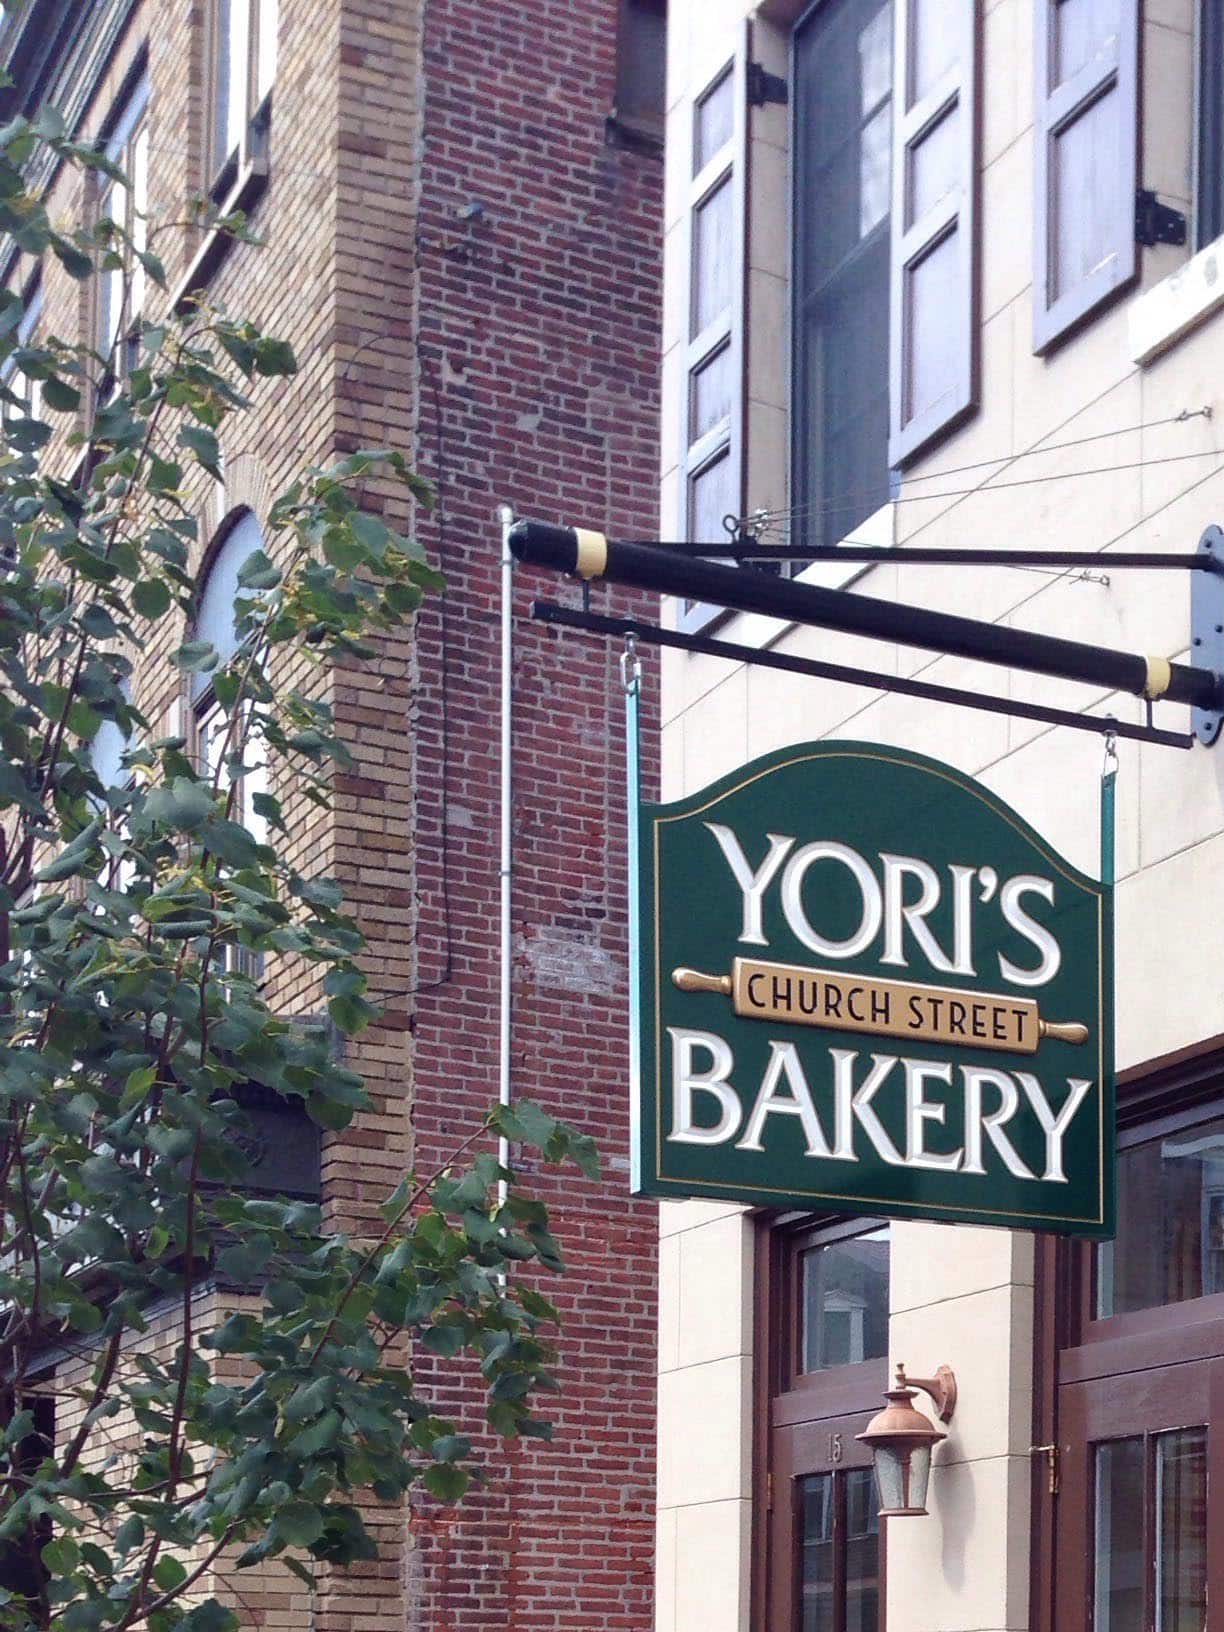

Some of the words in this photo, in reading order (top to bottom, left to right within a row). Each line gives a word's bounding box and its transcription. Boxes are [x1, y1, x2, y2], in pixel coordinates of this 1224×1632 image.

[703, 822, 1062, 988] YORI'S
[747, 973, 891, 1026] CHURCH
[908, 996, 1030, 1043] STREET
[666, 1027, 1093, 1184] BAKERY
[826, 1433, 842, 1463] 15
